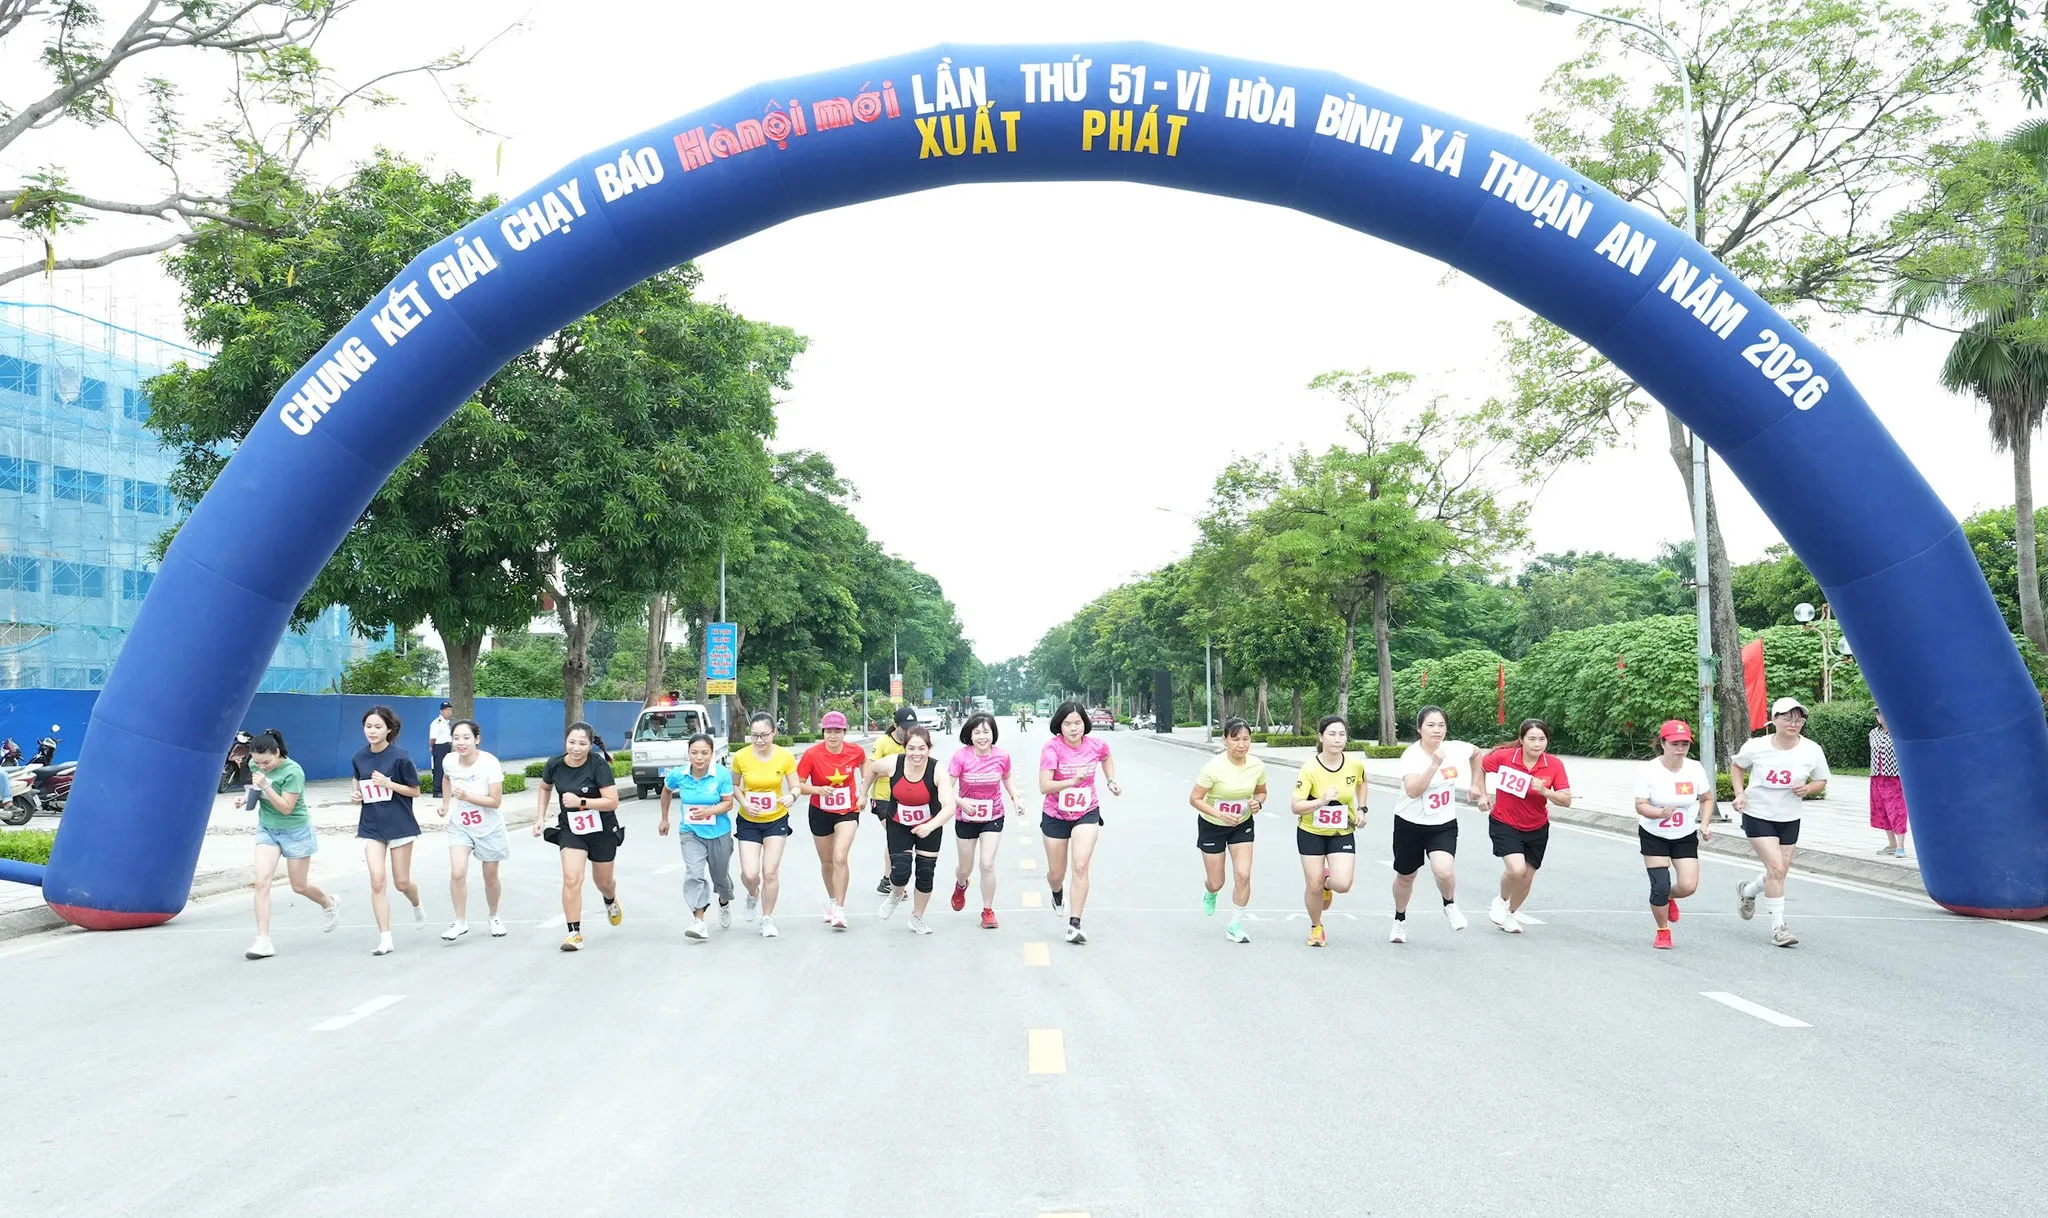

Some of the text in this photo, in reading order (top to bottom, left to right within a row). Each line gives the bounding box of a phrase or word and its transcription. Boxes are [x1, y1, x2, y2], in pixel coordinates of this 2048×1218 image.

[915, 100, 1188, 159] XUẤT PHÁT
[280, 337, 377, 435] CHUNG
[371, 281, 432, 346] KẾT
[428, 236, 497, 299] GIẢI
[501, 178, 586, 250] CHẠY
[594, 147, 664, 202] BÁO
[912, 57, 988, 114] LẦN
[1020, 54, 1092, 103] THỨ
[1225, 76, 1295, 127] HÒA
[1316, 94, 1403, 154] BÌNH
[1411, 124, 1468, 177] XÃ
[1481, 150, 1593, 238] THUẬN
[1595, 222, 1656, 275] AN
[1658, 258, 1748, 339] NĂM
[1741, 328, 1830, 412] 2026
[1500, 771, 1526, 792] 129
[1766, 769, 1792, 785] 43
[750, 796, 772, 810] 59
[825, 792, 846, 806] 66
[1064, 792, 1087, 808] 64
[1428, 790, 1450, 809] 30
[689, 807, 712, 821] 3
[902, 809, 924, 822] 50
[1219, 802, 1242, 814] 60
[461, 810, 482, 826] 35
[574, 814, 595, 830] 31
[1318, 809, 1342, 825] 58
[1659, 812, 1683, 828] 29
